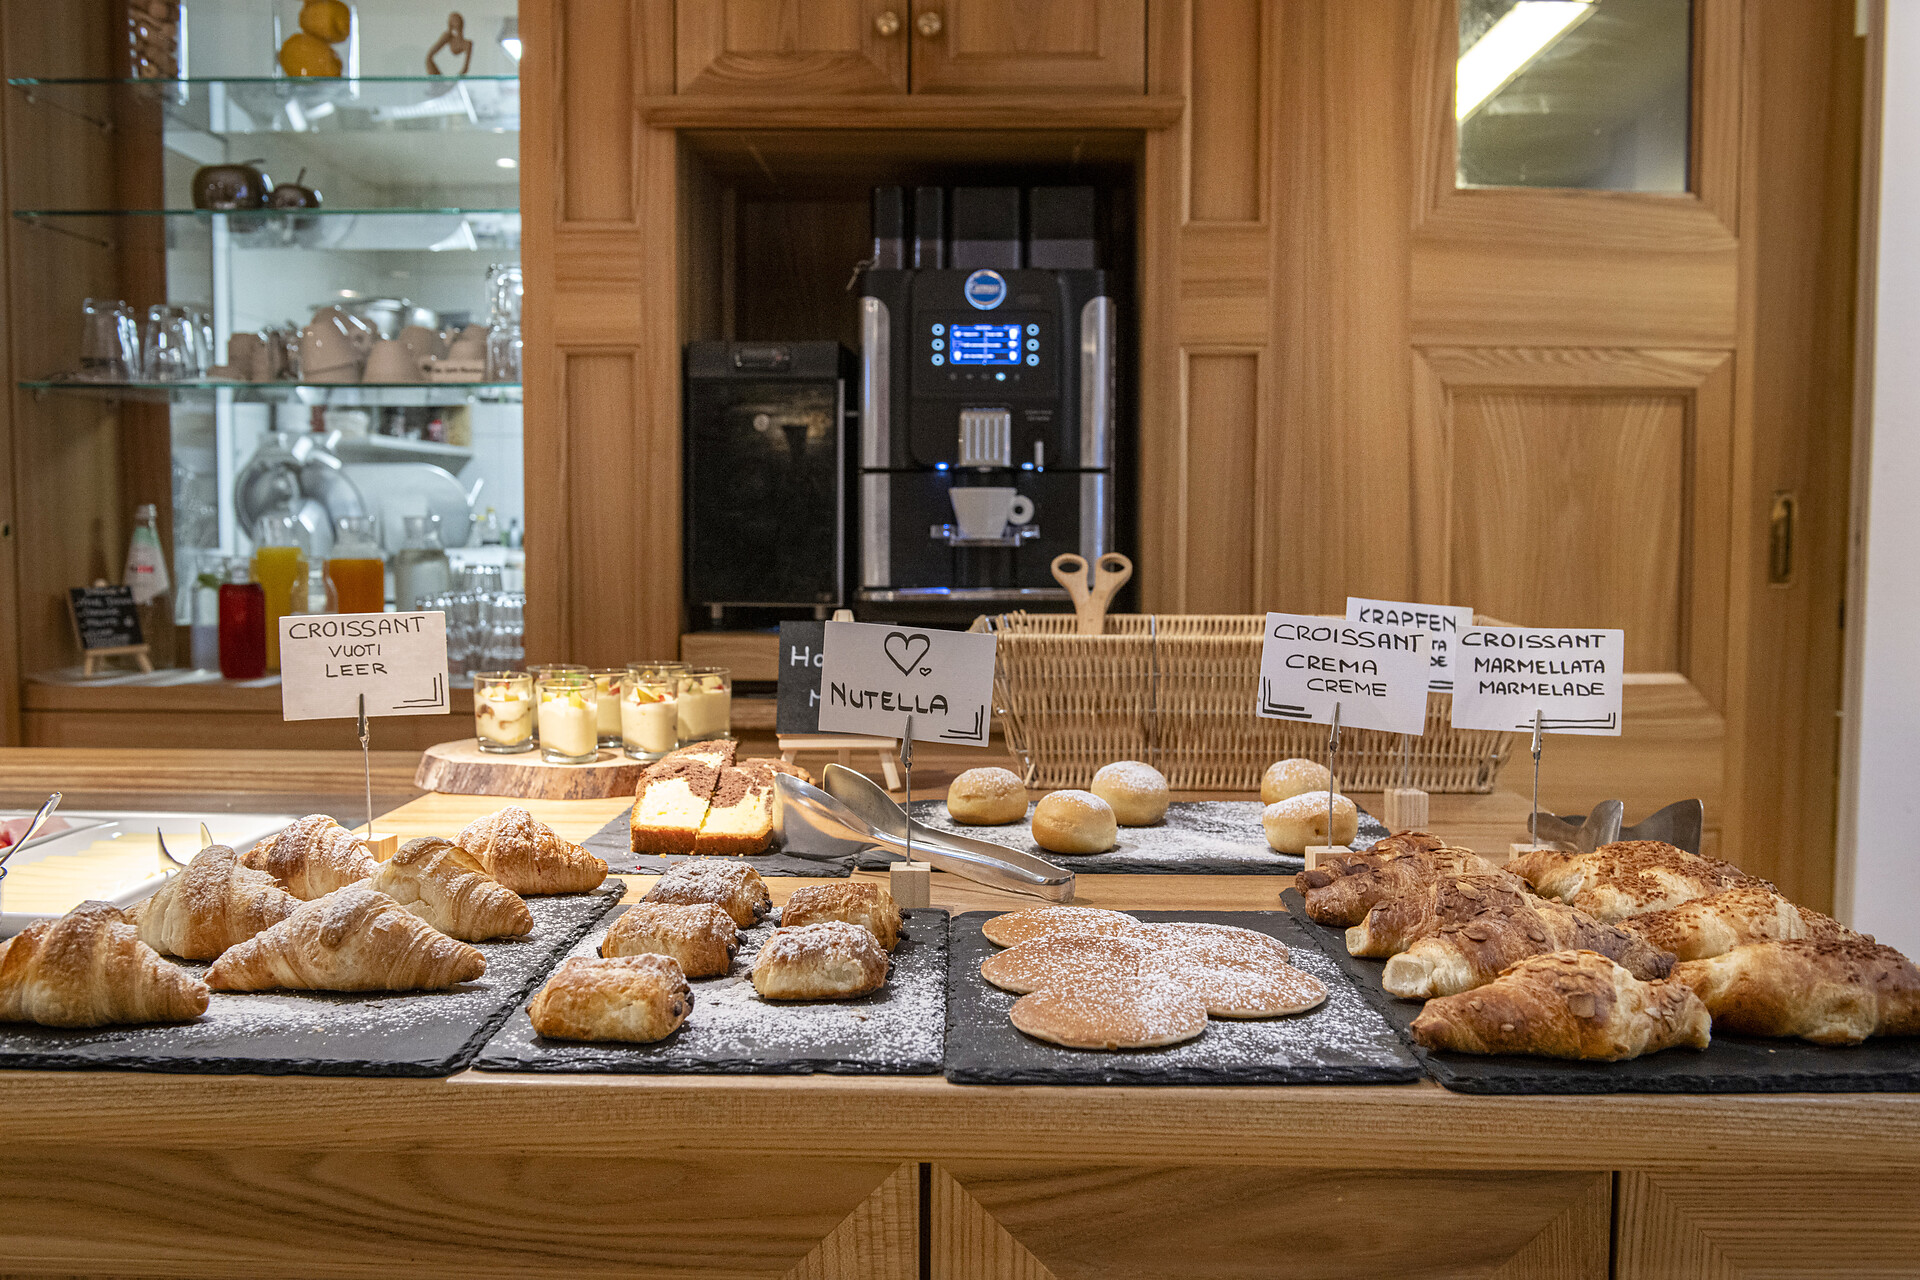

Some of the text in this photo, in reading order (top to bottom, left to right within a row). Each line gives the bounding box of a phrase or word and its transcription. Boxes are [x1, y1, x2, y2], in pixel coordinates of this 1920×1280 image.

[289, 616, 425, 639] CROISSANT
[1359, 606, 1456, 634] KRAPFEN
[1274, 624, 1424, 653] CROISSANT
[1462, 632, 1606, 649] CROISSANT
[328, 644, 381, 657] VUOTI
[326, 663, 388, 678] LEER
[1286, 654, 1378, 675] CREMA
[1474, 657, 1605, 675] MARMELLATA
[1307, 678, 1387, 697] CREME
[1479, 681, 1605, 697] MARMELADE
[831, 682, 949, 716] NUTELLA
